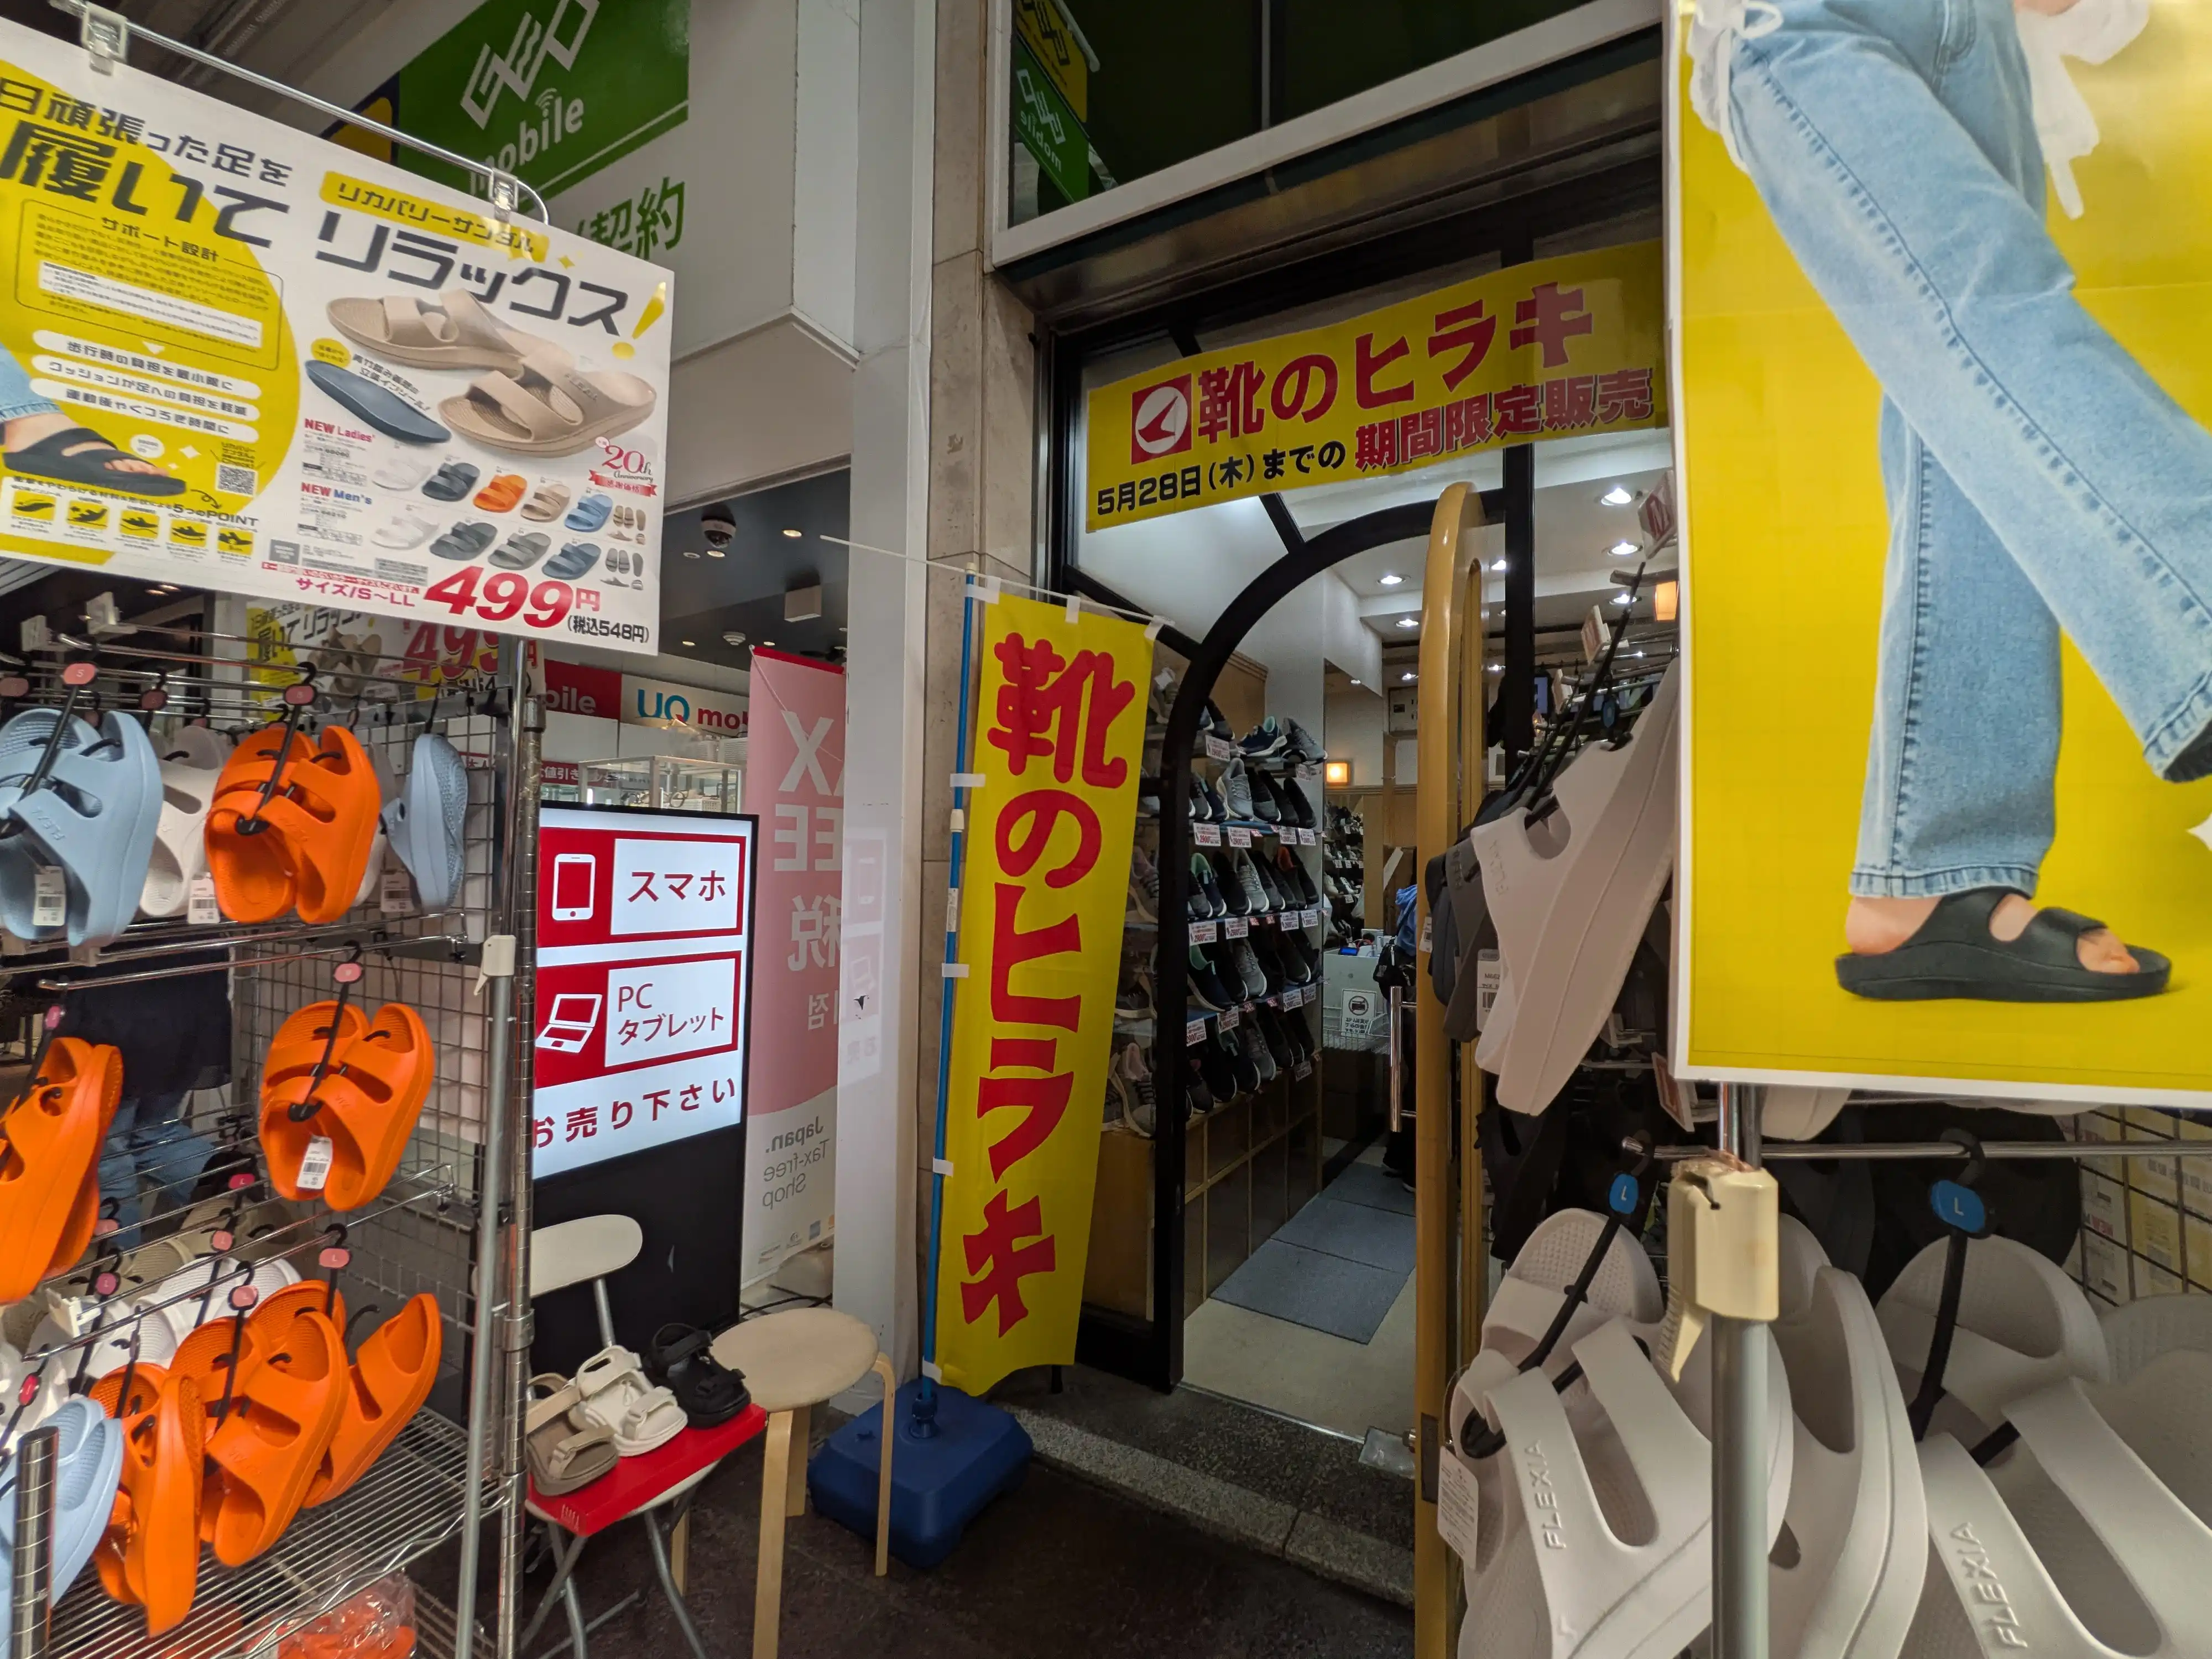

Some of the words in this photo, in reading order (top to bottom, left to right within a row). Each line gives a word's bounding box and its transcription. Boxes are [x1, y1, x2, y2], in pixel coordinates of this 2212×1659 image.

[0, 119, 289, 248] 履いて
[101, 216, 218, 263] サポート設計
[575, 176, 685, 261] 契約
[1198, 281, 1593, 445] 靴のヒラキ
[305, 418, 335, 434] NEW
[1354, 368, 1653, 471] 期間限定販売
[301, 482, 331, 497] NEW
[638, 689, 690, 723] UQ
[628, 870, 726, 902] スマホ
[618, 983, 653, 1012] PC
[961, 632, 1135, 1338] 靴のヒラキ
[617, 1008, 724, 1047] タブレット
[533, 1077, 735, 1149] お売り下さい
[1620, 1186, 1627, 1201] L
[1954, 1196, 1964, 1215] L
[1525, 1439, 1566, 1549] FLEXIA
[1951, 1522, 2028, 1649] FLEXIA
